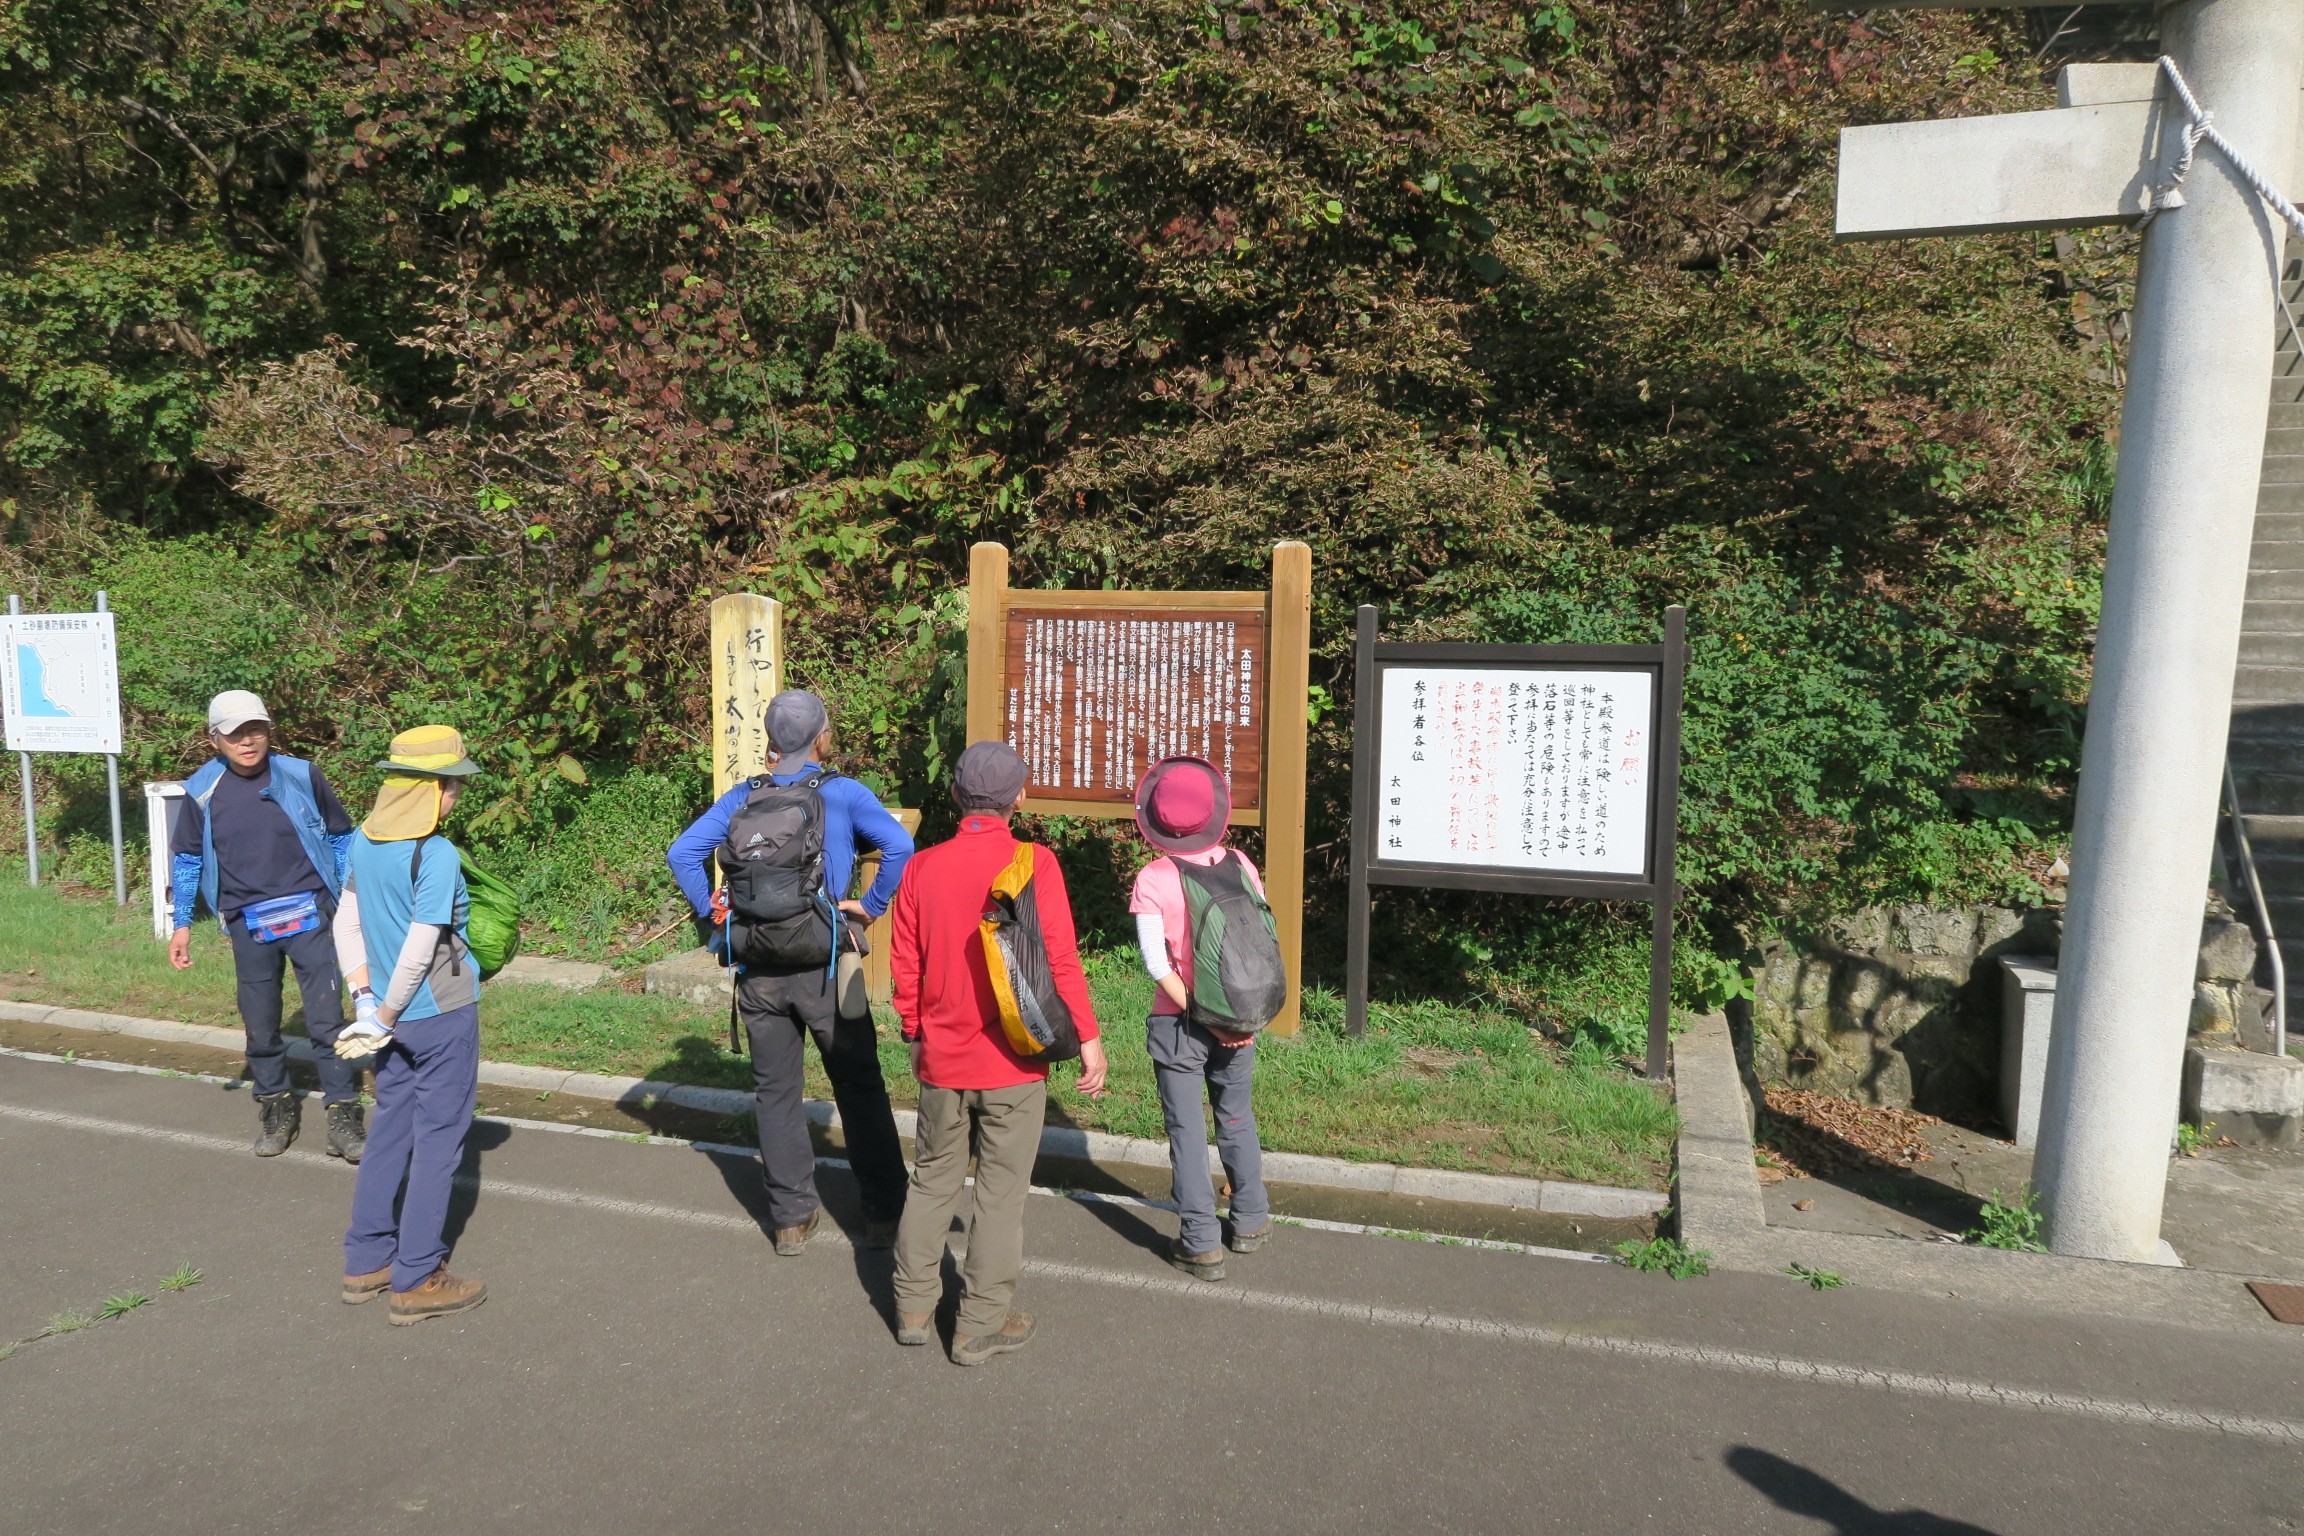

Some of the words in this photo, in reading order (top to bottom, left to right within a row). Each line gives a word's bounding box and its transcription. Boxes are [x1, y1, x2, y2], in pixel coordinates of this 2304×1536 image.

[1239, 648, 1252, 727] 太田神社の由来
[1411, 679, 1426, 762] 参拝者各位
[1619, 728, 1641, 787] お願い
[1388, 775, 1402, 849] 太田神社
